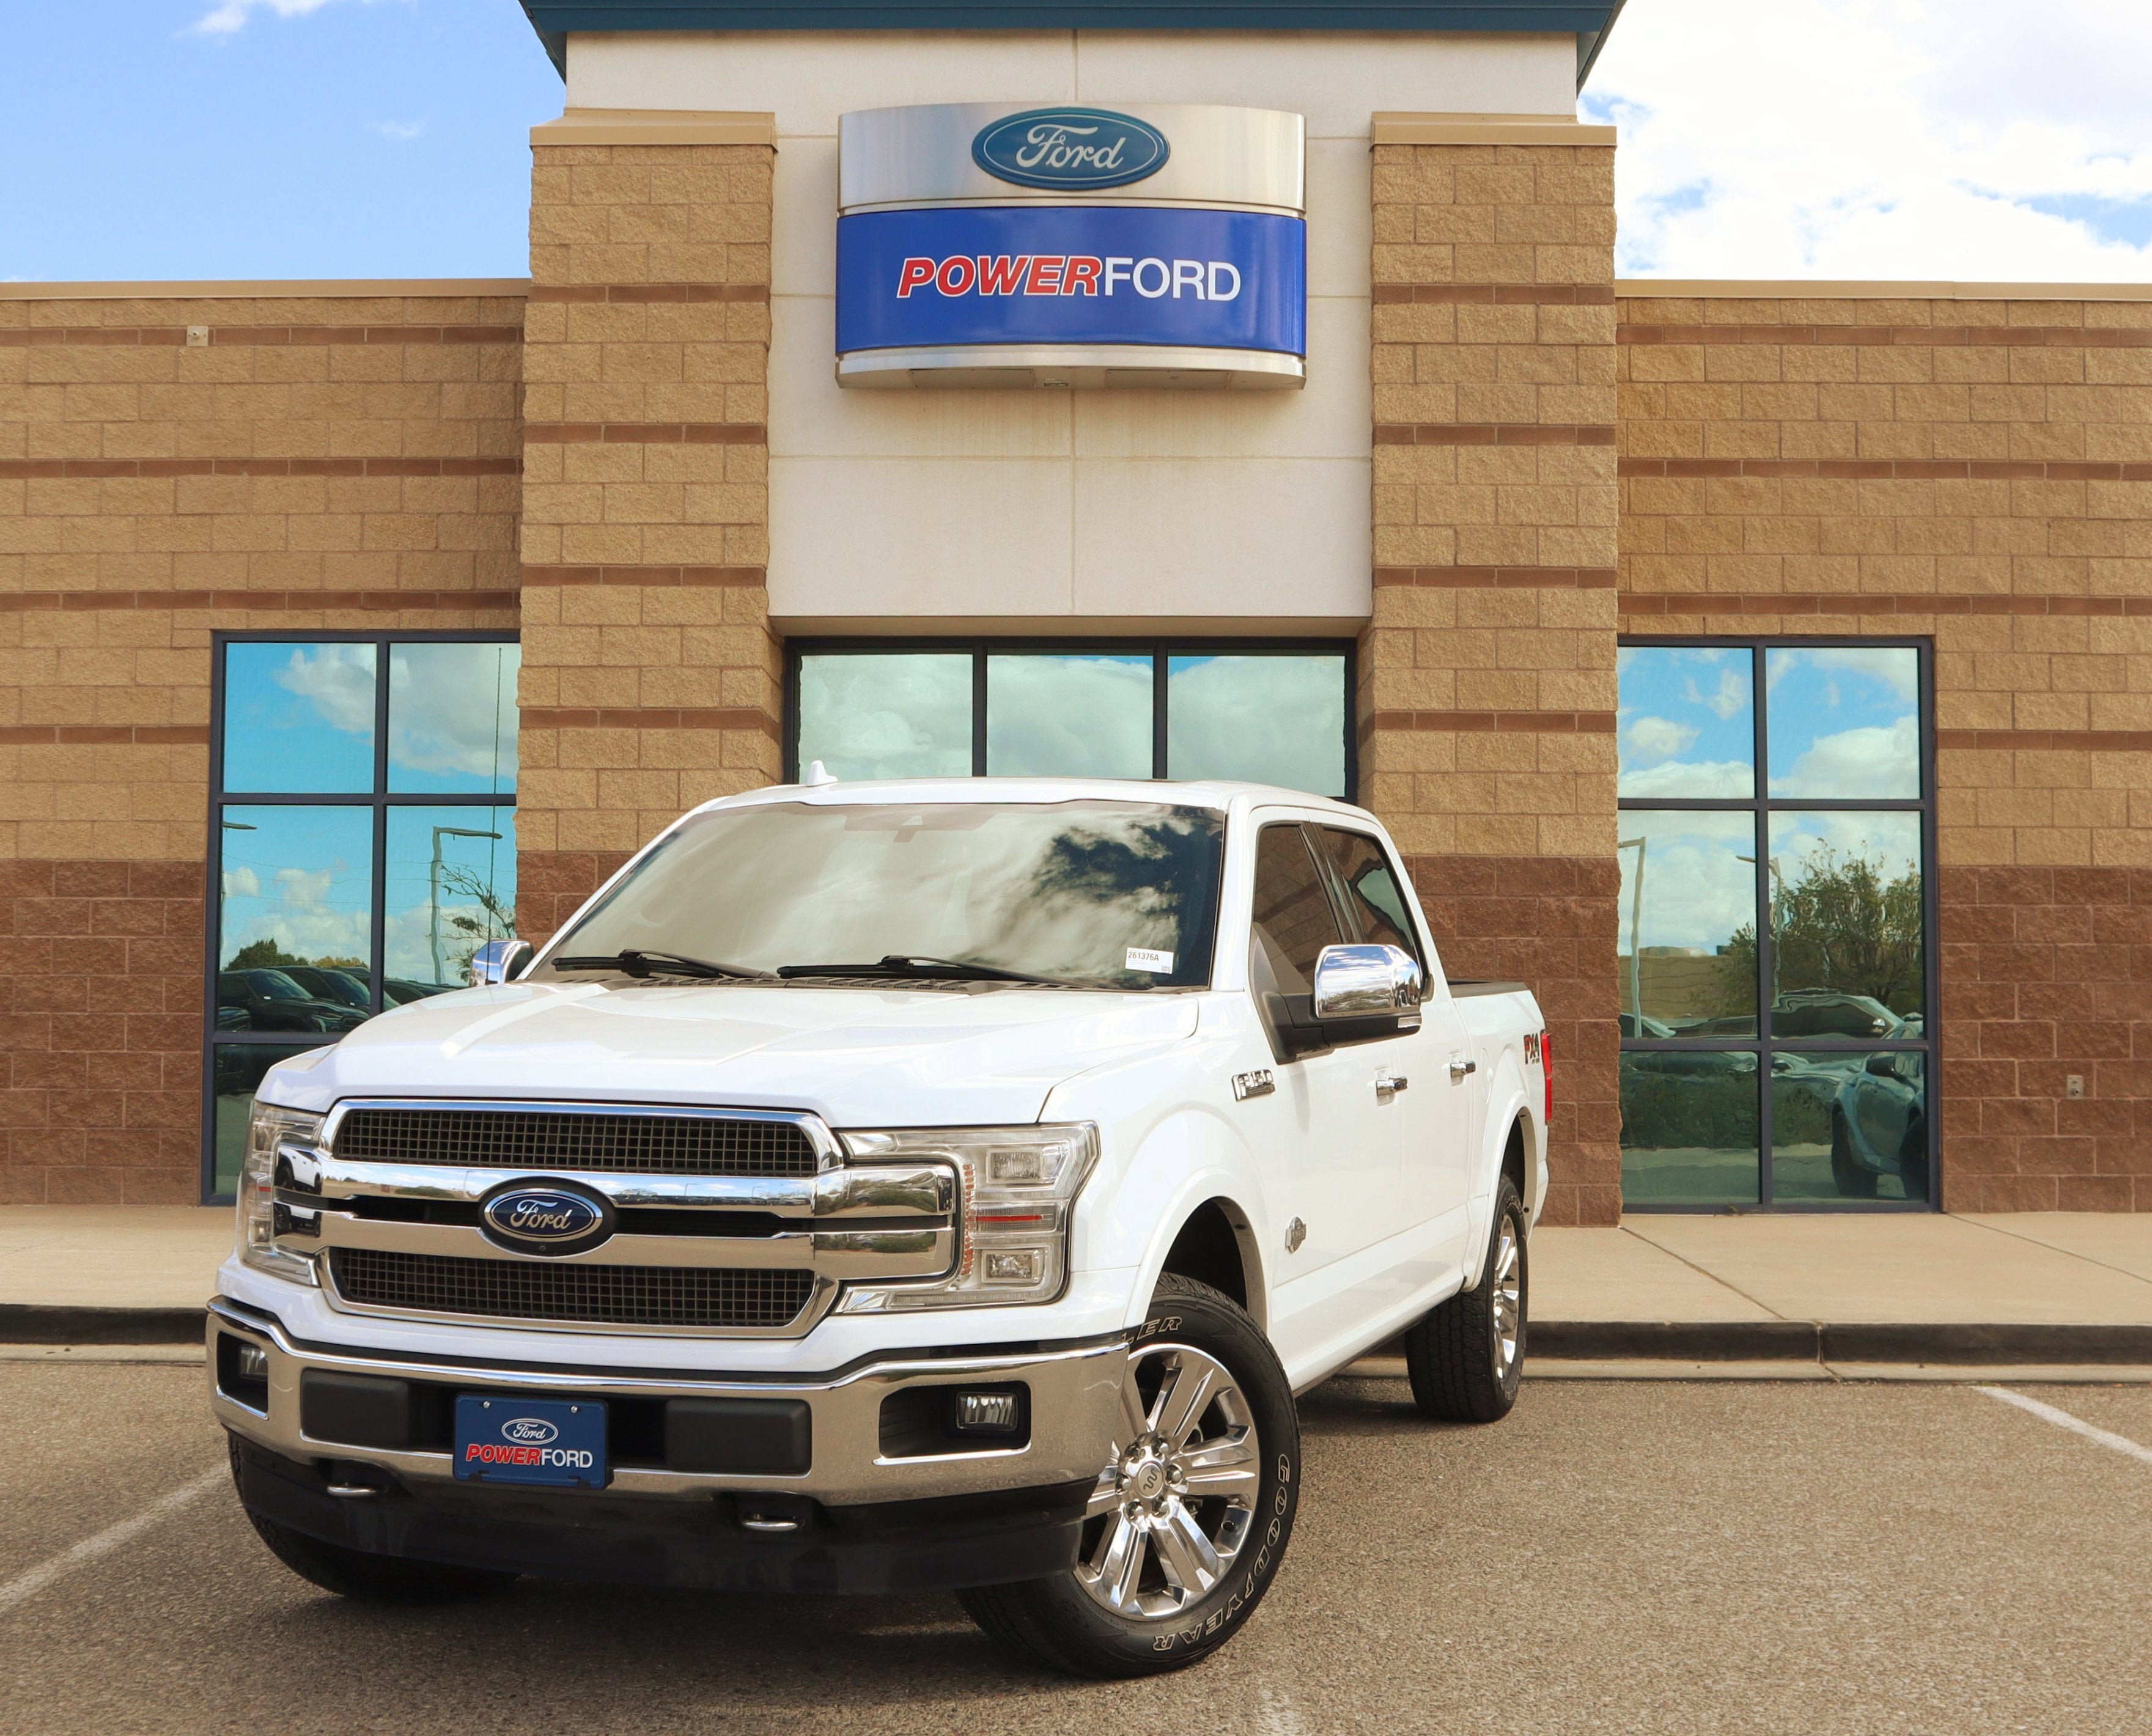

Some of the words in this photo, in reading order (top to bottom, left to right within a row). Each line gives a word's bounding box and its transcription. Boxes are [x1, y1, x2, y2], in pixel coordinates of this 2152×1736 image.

[1015, 123, 1126, 169] Ford
[1128, 951, 1159, 962] 261376A
[1524, 1032, 1540, 1064] FX4
[510, 1199, 573, 1230] Ford
[513, 1422, 547, 1440] Ford
[1152, 1454, 1291, 1651] GOODYEAR
